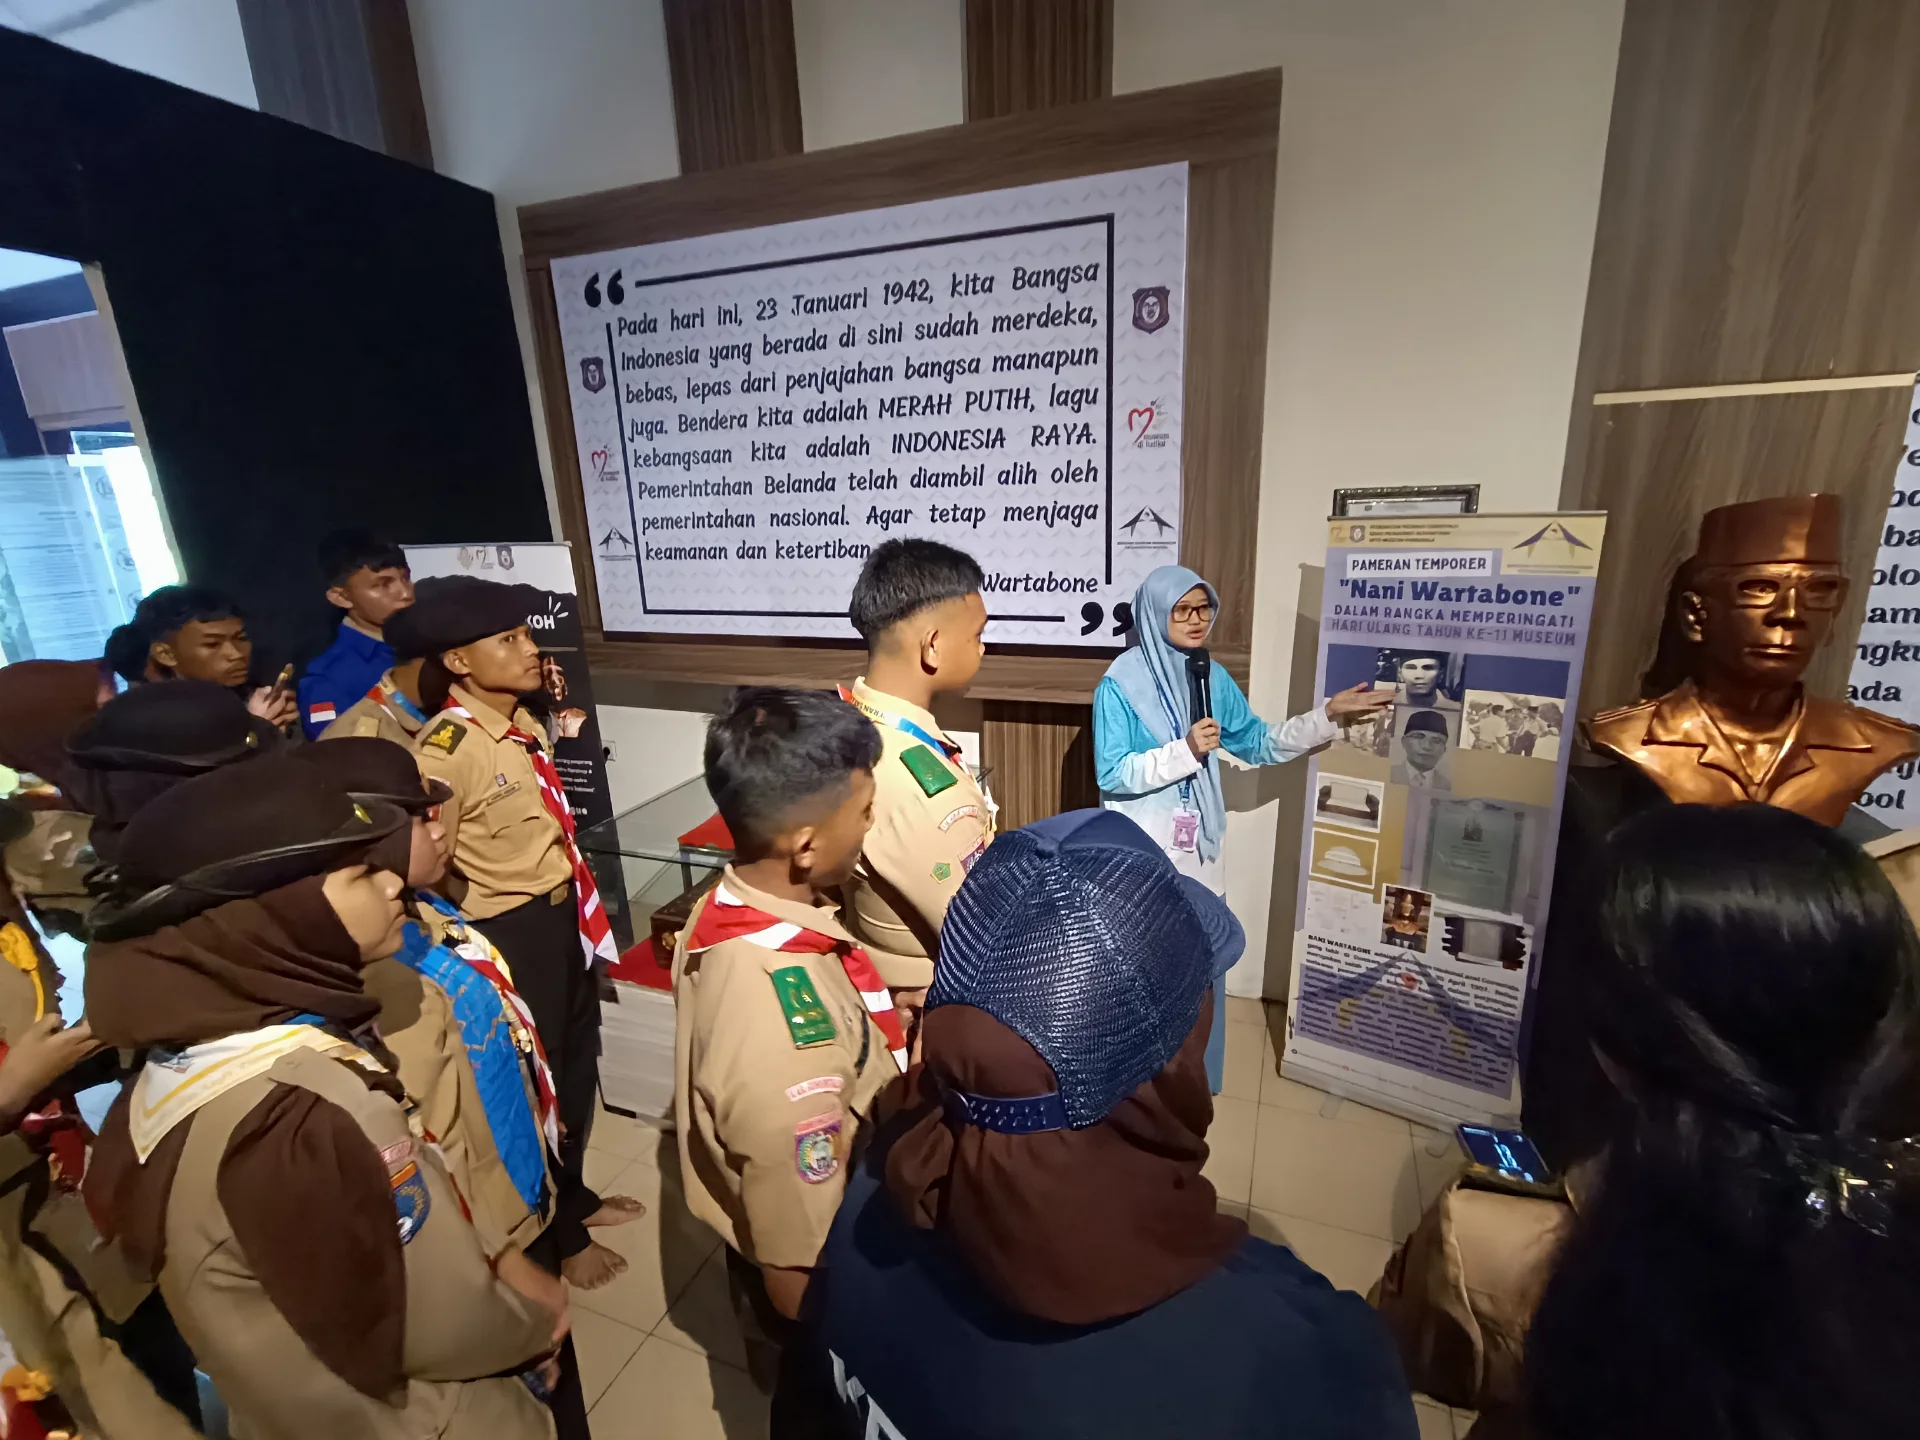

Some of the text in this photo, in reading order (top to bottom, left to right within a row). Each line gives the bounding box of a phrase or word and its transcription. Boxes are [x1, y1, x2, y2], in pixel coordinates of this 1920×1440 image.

[618, 312, 657, 337] Pada
[670, 307, 704, 331] hari
[718, 303, 742, 326] ini,
[756, 298, 778, 321] 23
[883, 278, 934, 305] 1942,
[950, 272, 995, 298] kita
[1012, 262, 1100, 294] Bangsa
[621, 300, 1098, 371] Indonesia yang berada di sini sudah merdeka,
[626, 346, 1098, 404] bebas, lepas dari penjajahan bangsa manapun
[628, 382, 1099, 443] juga. Bendera kita adalah MERAH PUTIH, lagu
[633, 422, 1097, 471] kebangsaan kita adalah INDONESIA RAYA.
[638, 476, 752, 500] Pemerintahan
[764, 470, 836, 495] Belanda
[848, 467, 898, 491] telah
[910, 463, 985, 489] diambil
[997, 461, 1037, 485] alih
[1051, 458, 1099, 484] oleh
[642, 500, 1099, 536] pemerintahan nasional. Agar tetap menjaga
[645, 538, 871, 561] keamanan dan ketertiban
[1352, 557, 1487, 571] PAMERAN TEMPORER
[981, 571, 1099, 593] Wartabone
[1340, 579, 1582, 606] "Nani Wartabone"
[1332, 619, 1362, 631] HARI
[1367, 620, 1411, 635] ULANG
[1417, 624, 1462, 638] TAHUN
[1512, 629, 1576, 646] MUSEUM
[1334, 604, 1574, 628] DALAM RANGKA MEMPERINGATI
